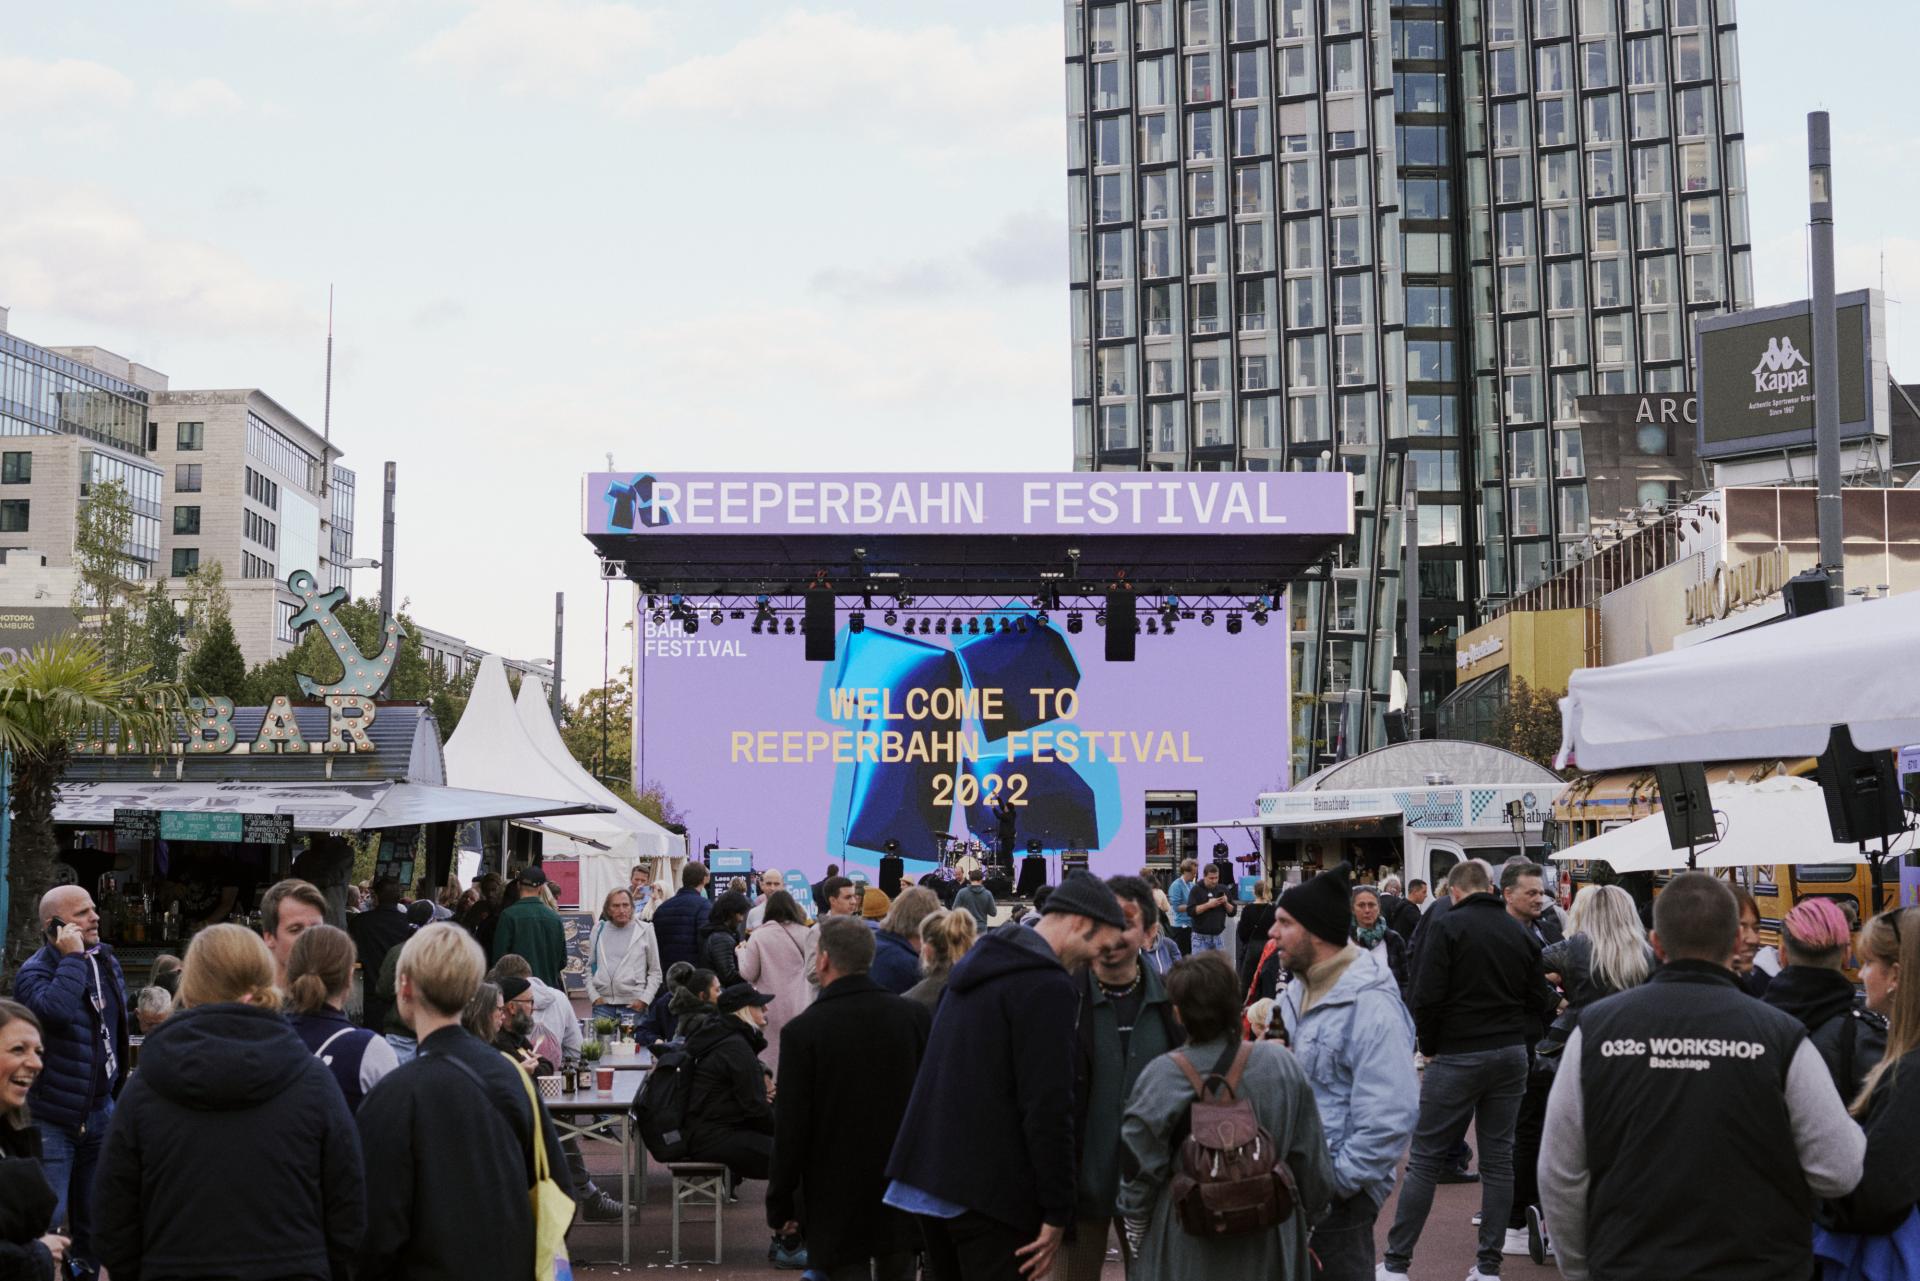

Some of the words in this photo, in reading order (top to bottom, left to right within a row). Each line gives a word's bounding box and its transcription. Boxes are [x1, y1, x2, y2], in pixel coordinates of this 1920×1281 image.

[1755, 368, 1808, 393] Kappa
[1749, 401, 1771, 409] Authentic
[652, 482, 984, 524] REEPERBAHN
[1023, 482, 1287, 524] FESTIVAL
[645, 621, 697, 638] BAH
[645, 640, 747, 657] FESTIVAL
[830, 687, 1003, 720] WELCOME
[1030, 687, 1079, 720] TO
[731, 731, 978, 763] REEPERBAHN
[1008, 731, 1204, 763] FESTIVAL
[931, 773, 1029, 806] 2022
[1601, 1039, 1647, 1057] 032c
[1649, 1038, 1766, 1060] WORKSHOP
[1649, 1056, 1711, 1071] Backstage
